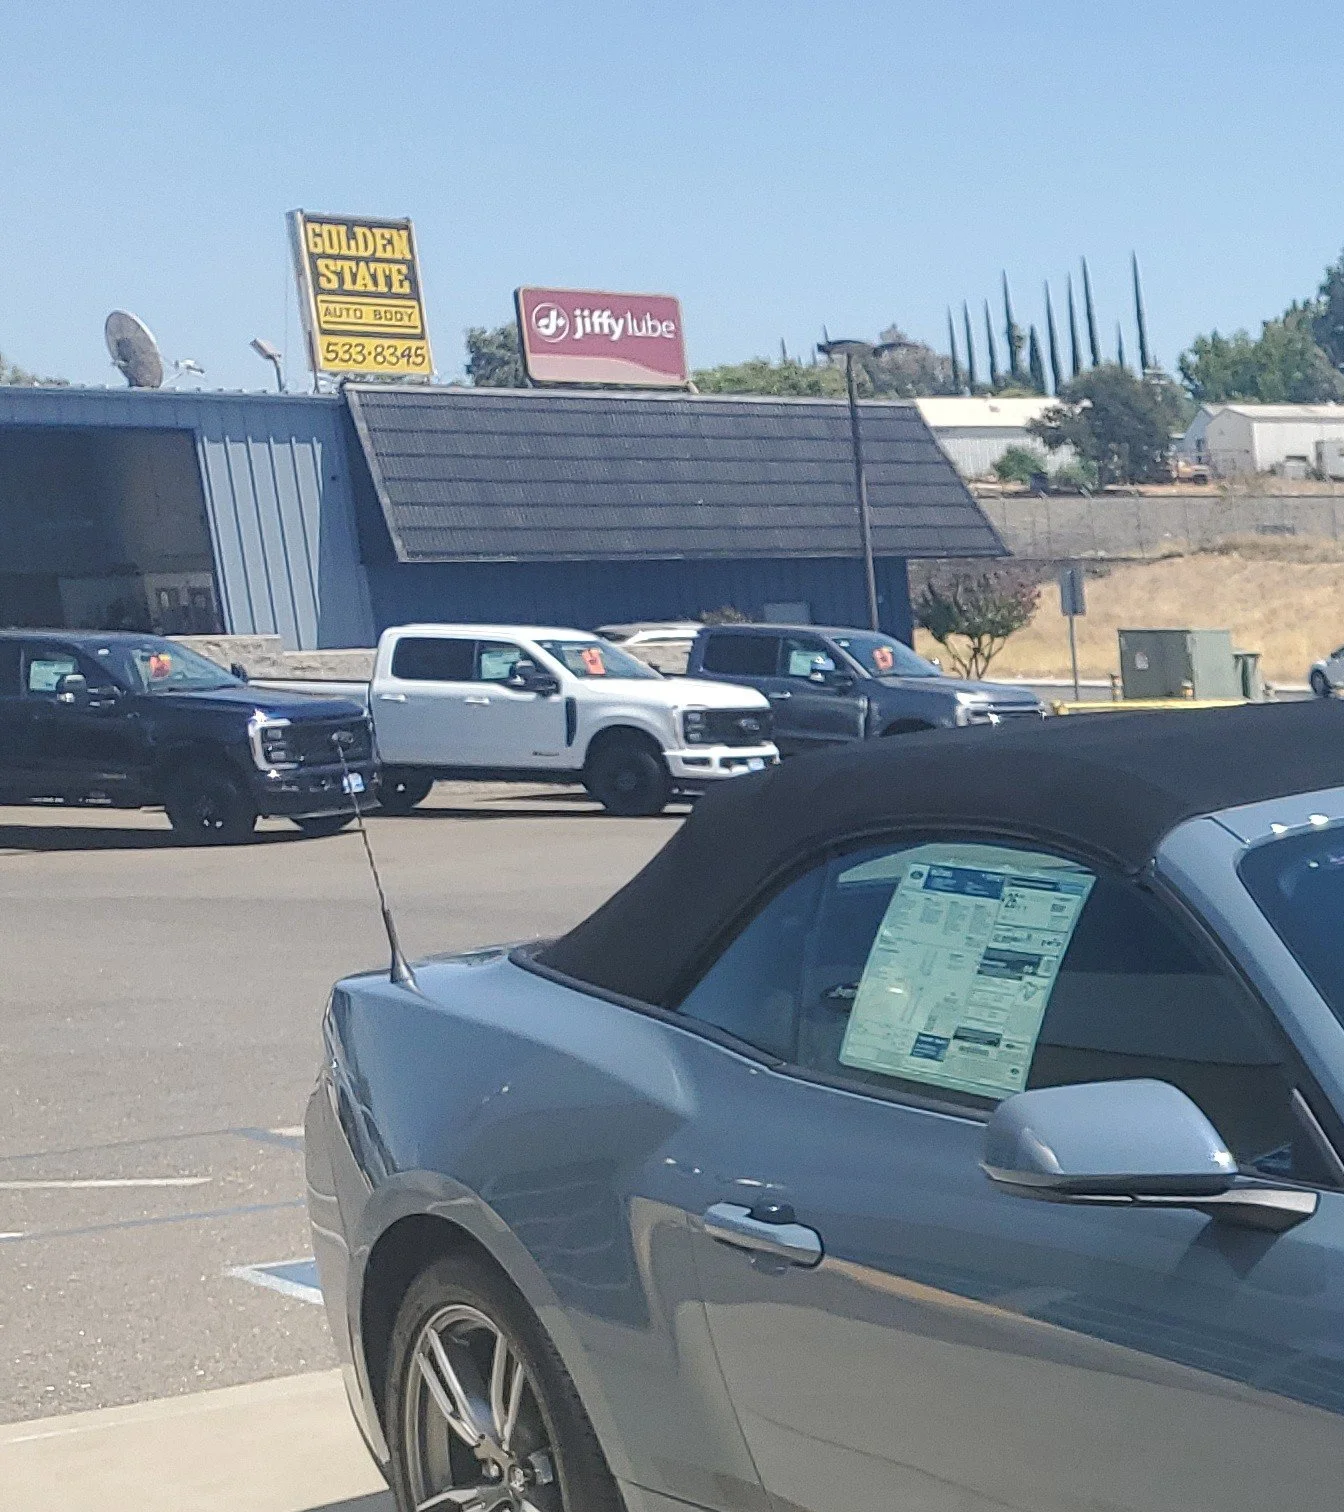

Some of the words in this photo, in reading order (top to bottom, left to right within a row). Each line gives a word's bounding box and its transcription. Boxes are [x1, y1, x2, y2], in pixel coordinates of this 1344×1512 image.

[306, 222, 412, 260] GOLDEN
[317, 258, 411, 294] STATE
[324, 305, 363, 320] AUTO
[373, 308, 415, 322] BODY
